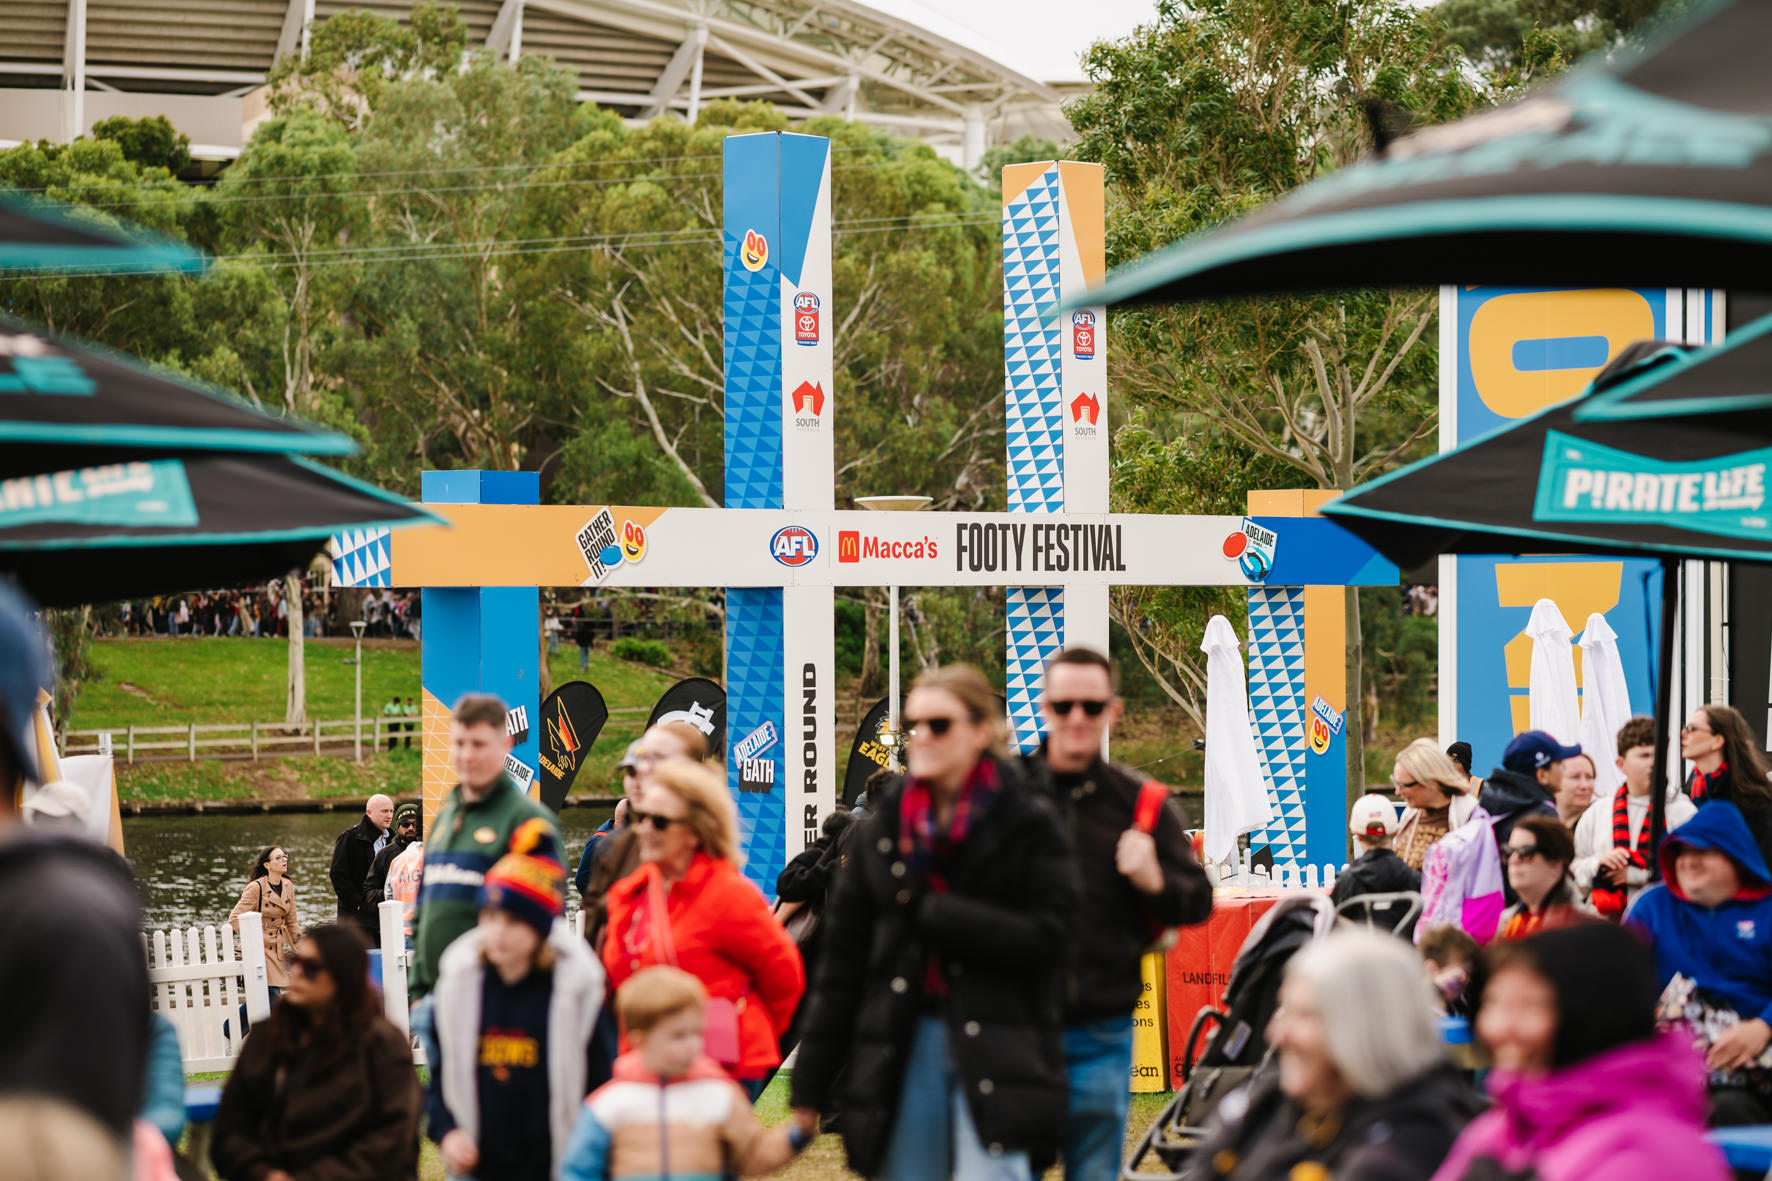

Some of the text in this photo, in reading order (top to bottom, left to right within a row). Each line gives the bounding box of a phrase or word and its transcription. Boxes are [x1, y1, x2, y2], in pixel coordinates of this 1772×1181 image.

[796, 296, 818, 309] AFL
[1074, 314, 1094, 325] AFL
[796, 418, 819, 427] SOUTH
[1075, 427, 1096, 436] SOUTH
[578, 510, 612, 550] GATHER
[1245, 524, 1274, 547] ADELAIDE
[584, 527, 616, 565] ROUND
[774, 535, 815, 559] AFL
[863, 523, 1127, 572] Macca's FOOTY FESTIVAL
[505, 704, 529, 736] ATH
[1312, 696, 1341, 727] ADELAIDE
[736, 725, 771, 764] ADELAIDE
[802, 663, 818, 850] ER ROUND
[858, 740, 907, 776] EAGLS
[504, 756, 530, 781] DELAIDE
[743, 758, 775, 784] GATH
